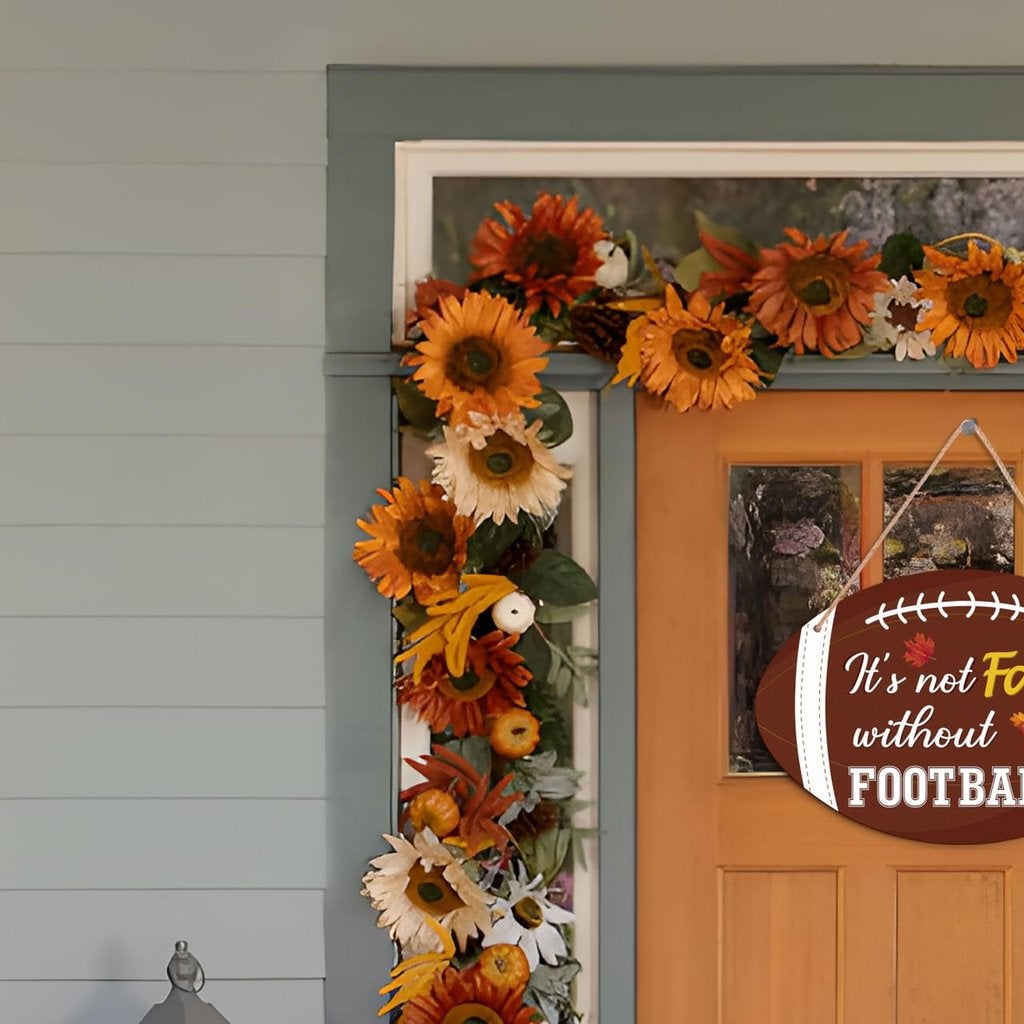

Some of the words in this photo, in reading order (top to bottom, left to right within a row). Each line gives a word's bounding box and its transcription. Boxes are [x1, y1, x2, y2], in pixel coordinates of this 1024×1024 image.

[844, 652, 906, 695] It's
[915, 656, 976, 695] not
[852, 704, 997, 749] without
